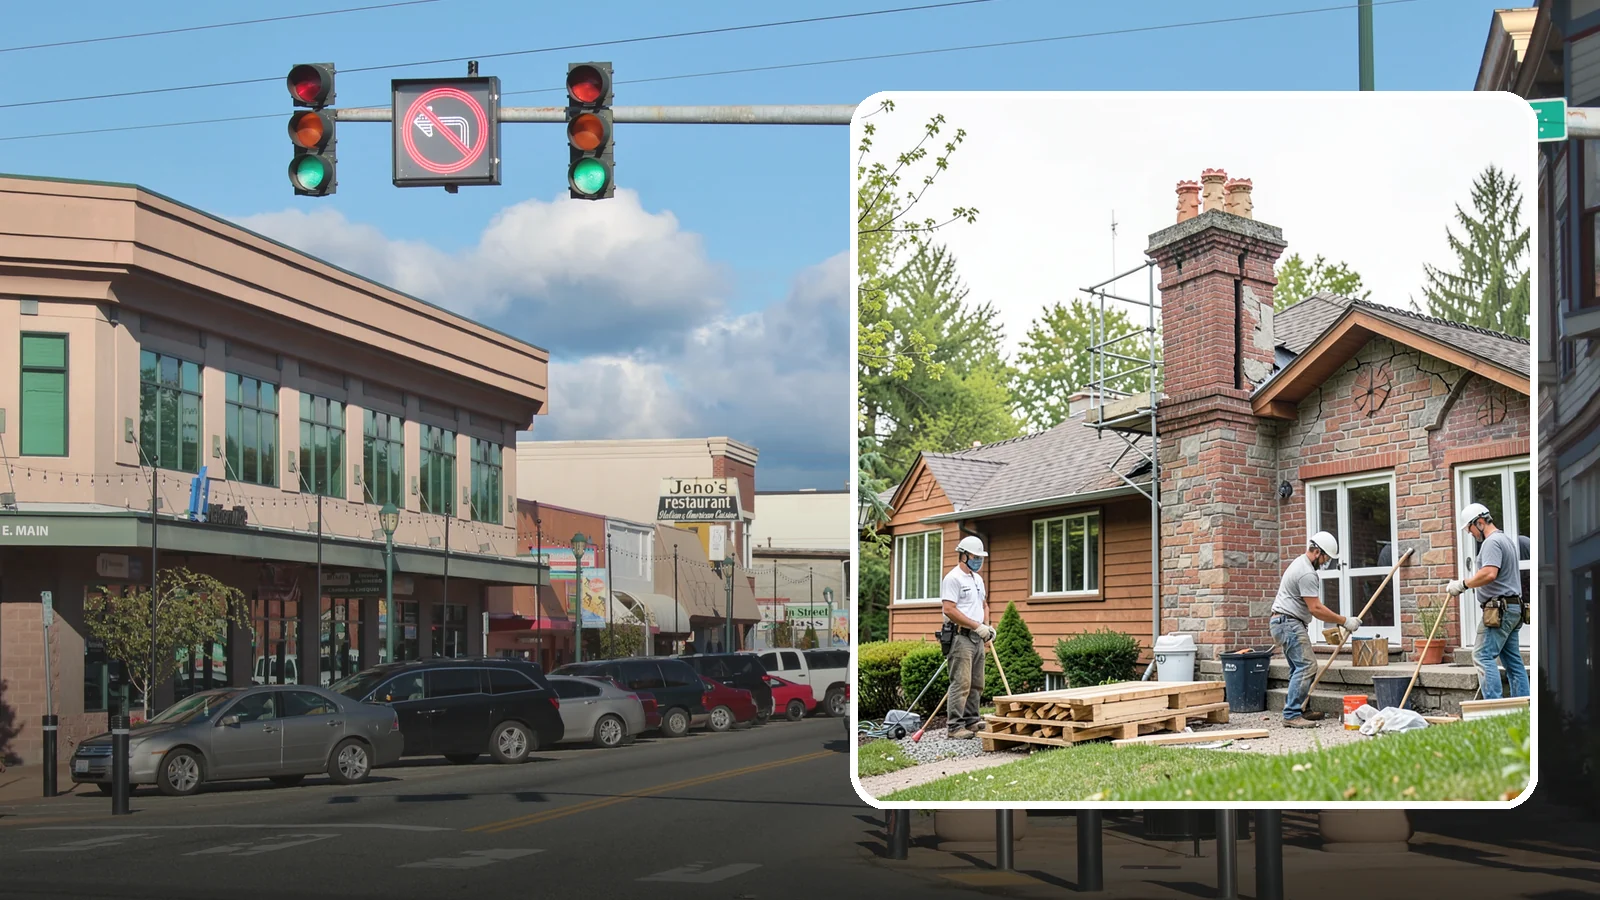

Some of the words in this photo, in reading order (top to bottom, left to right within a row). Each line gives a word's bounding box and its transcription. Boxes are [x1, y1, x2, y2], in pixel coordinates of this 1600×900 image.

[669, 479, 727, 494] Jeno's
[665, 496, 731, 509] restaurant
[658, 510, 681, 519] Italian
[686, 510, 715, 519] American
[715, 509, 737, 519] Cuisine
[2, 525, 13, 536] E.
[15, 525, 49, 536] MAIN
[797, 607, 828, 616] Street
